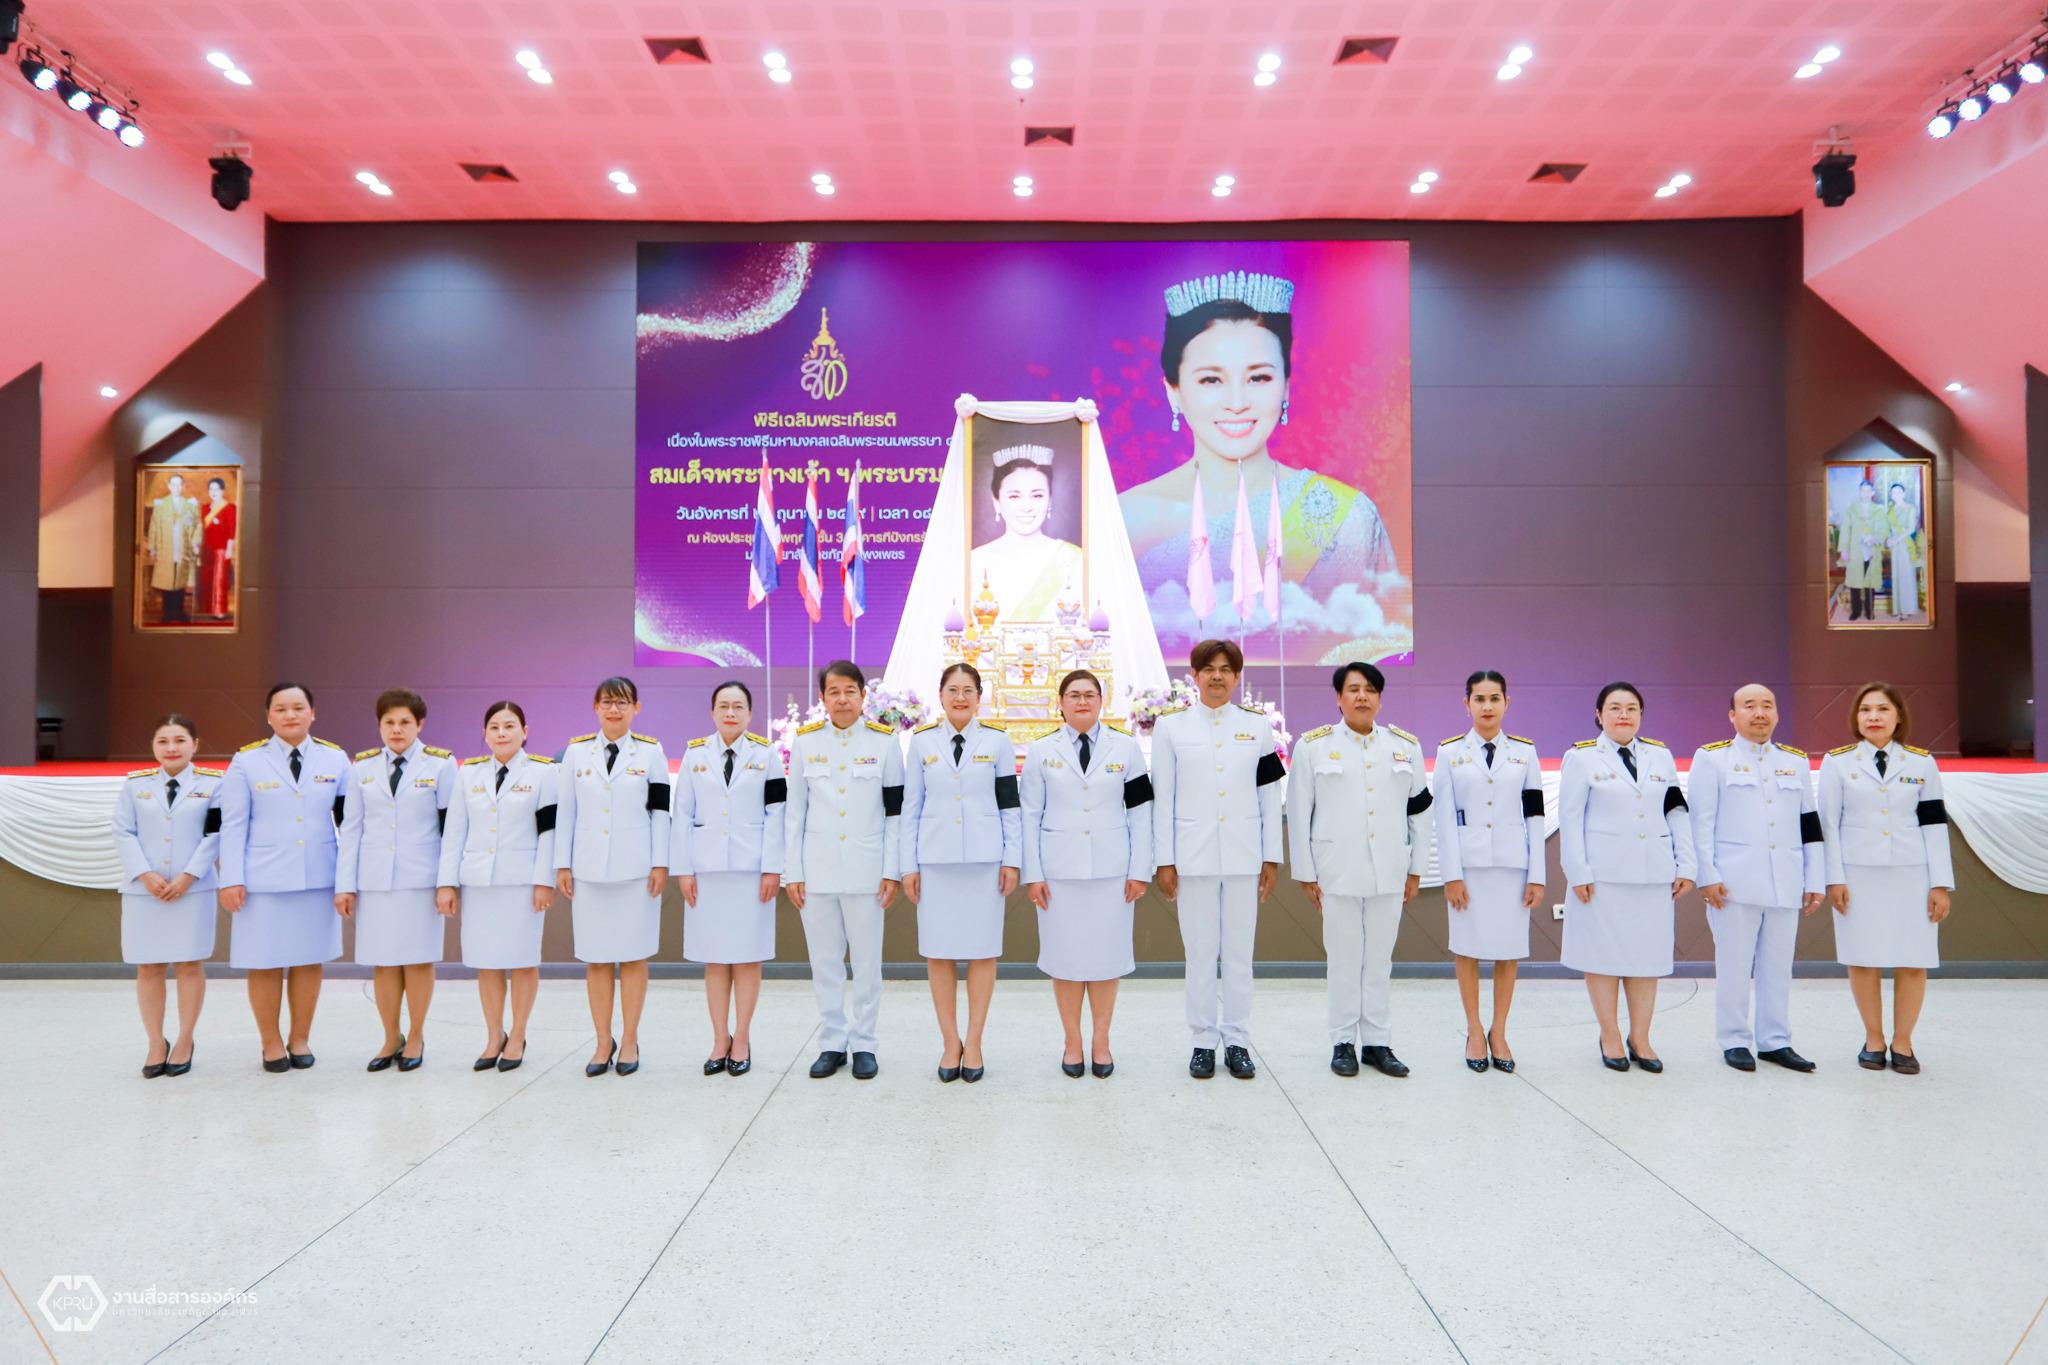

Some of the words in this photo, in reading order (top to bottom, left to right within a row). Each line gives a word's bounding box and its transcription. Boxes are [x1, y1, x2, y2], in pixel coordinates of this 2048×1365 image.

[753, 411, 897, 428] พิธีเฉลิมพระเกียรติ
[667, 432, 942, 448] เนื่องในพระราชพิธีมหามงคลเฉลิมพระชนมพรรษา
[676, 504, 749, 520] วันอังคารที่
[878, 508, 909, 520] เวลา
[687, 533, 700, 544] ณ
